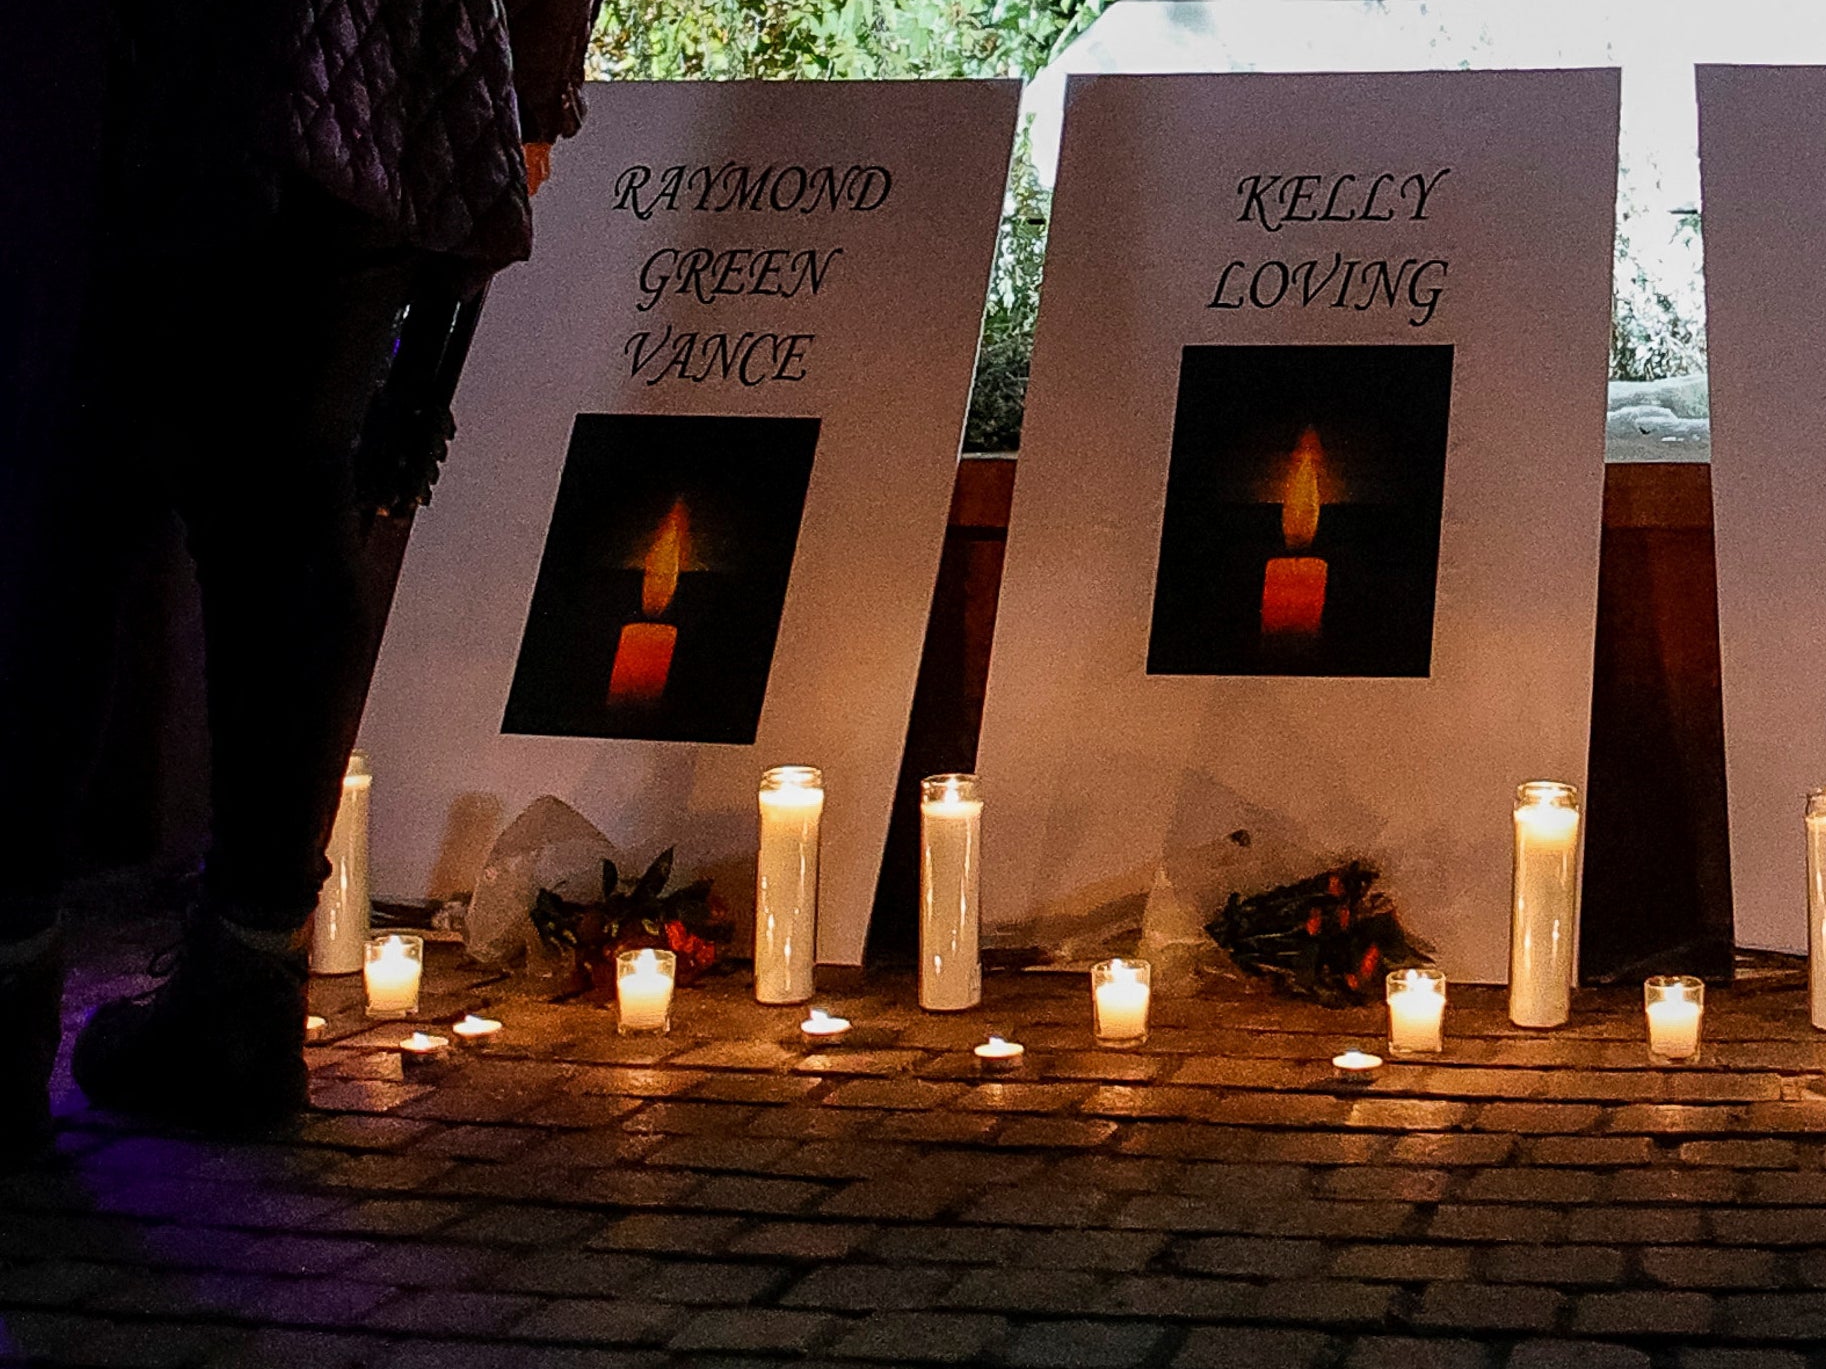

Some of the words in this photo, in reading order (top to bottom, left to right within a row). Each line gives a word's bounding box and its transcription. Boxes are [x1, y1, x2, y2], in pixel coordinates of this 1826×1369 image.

[612, 161, 893, 220] RAYMOND
[1236, 168, 1451, 232] KELLY
[636, 247, 844, 312] GREEN
[1206, 252, 1449, 327] LOVING
[624, 326, 815, 387] VANCE
